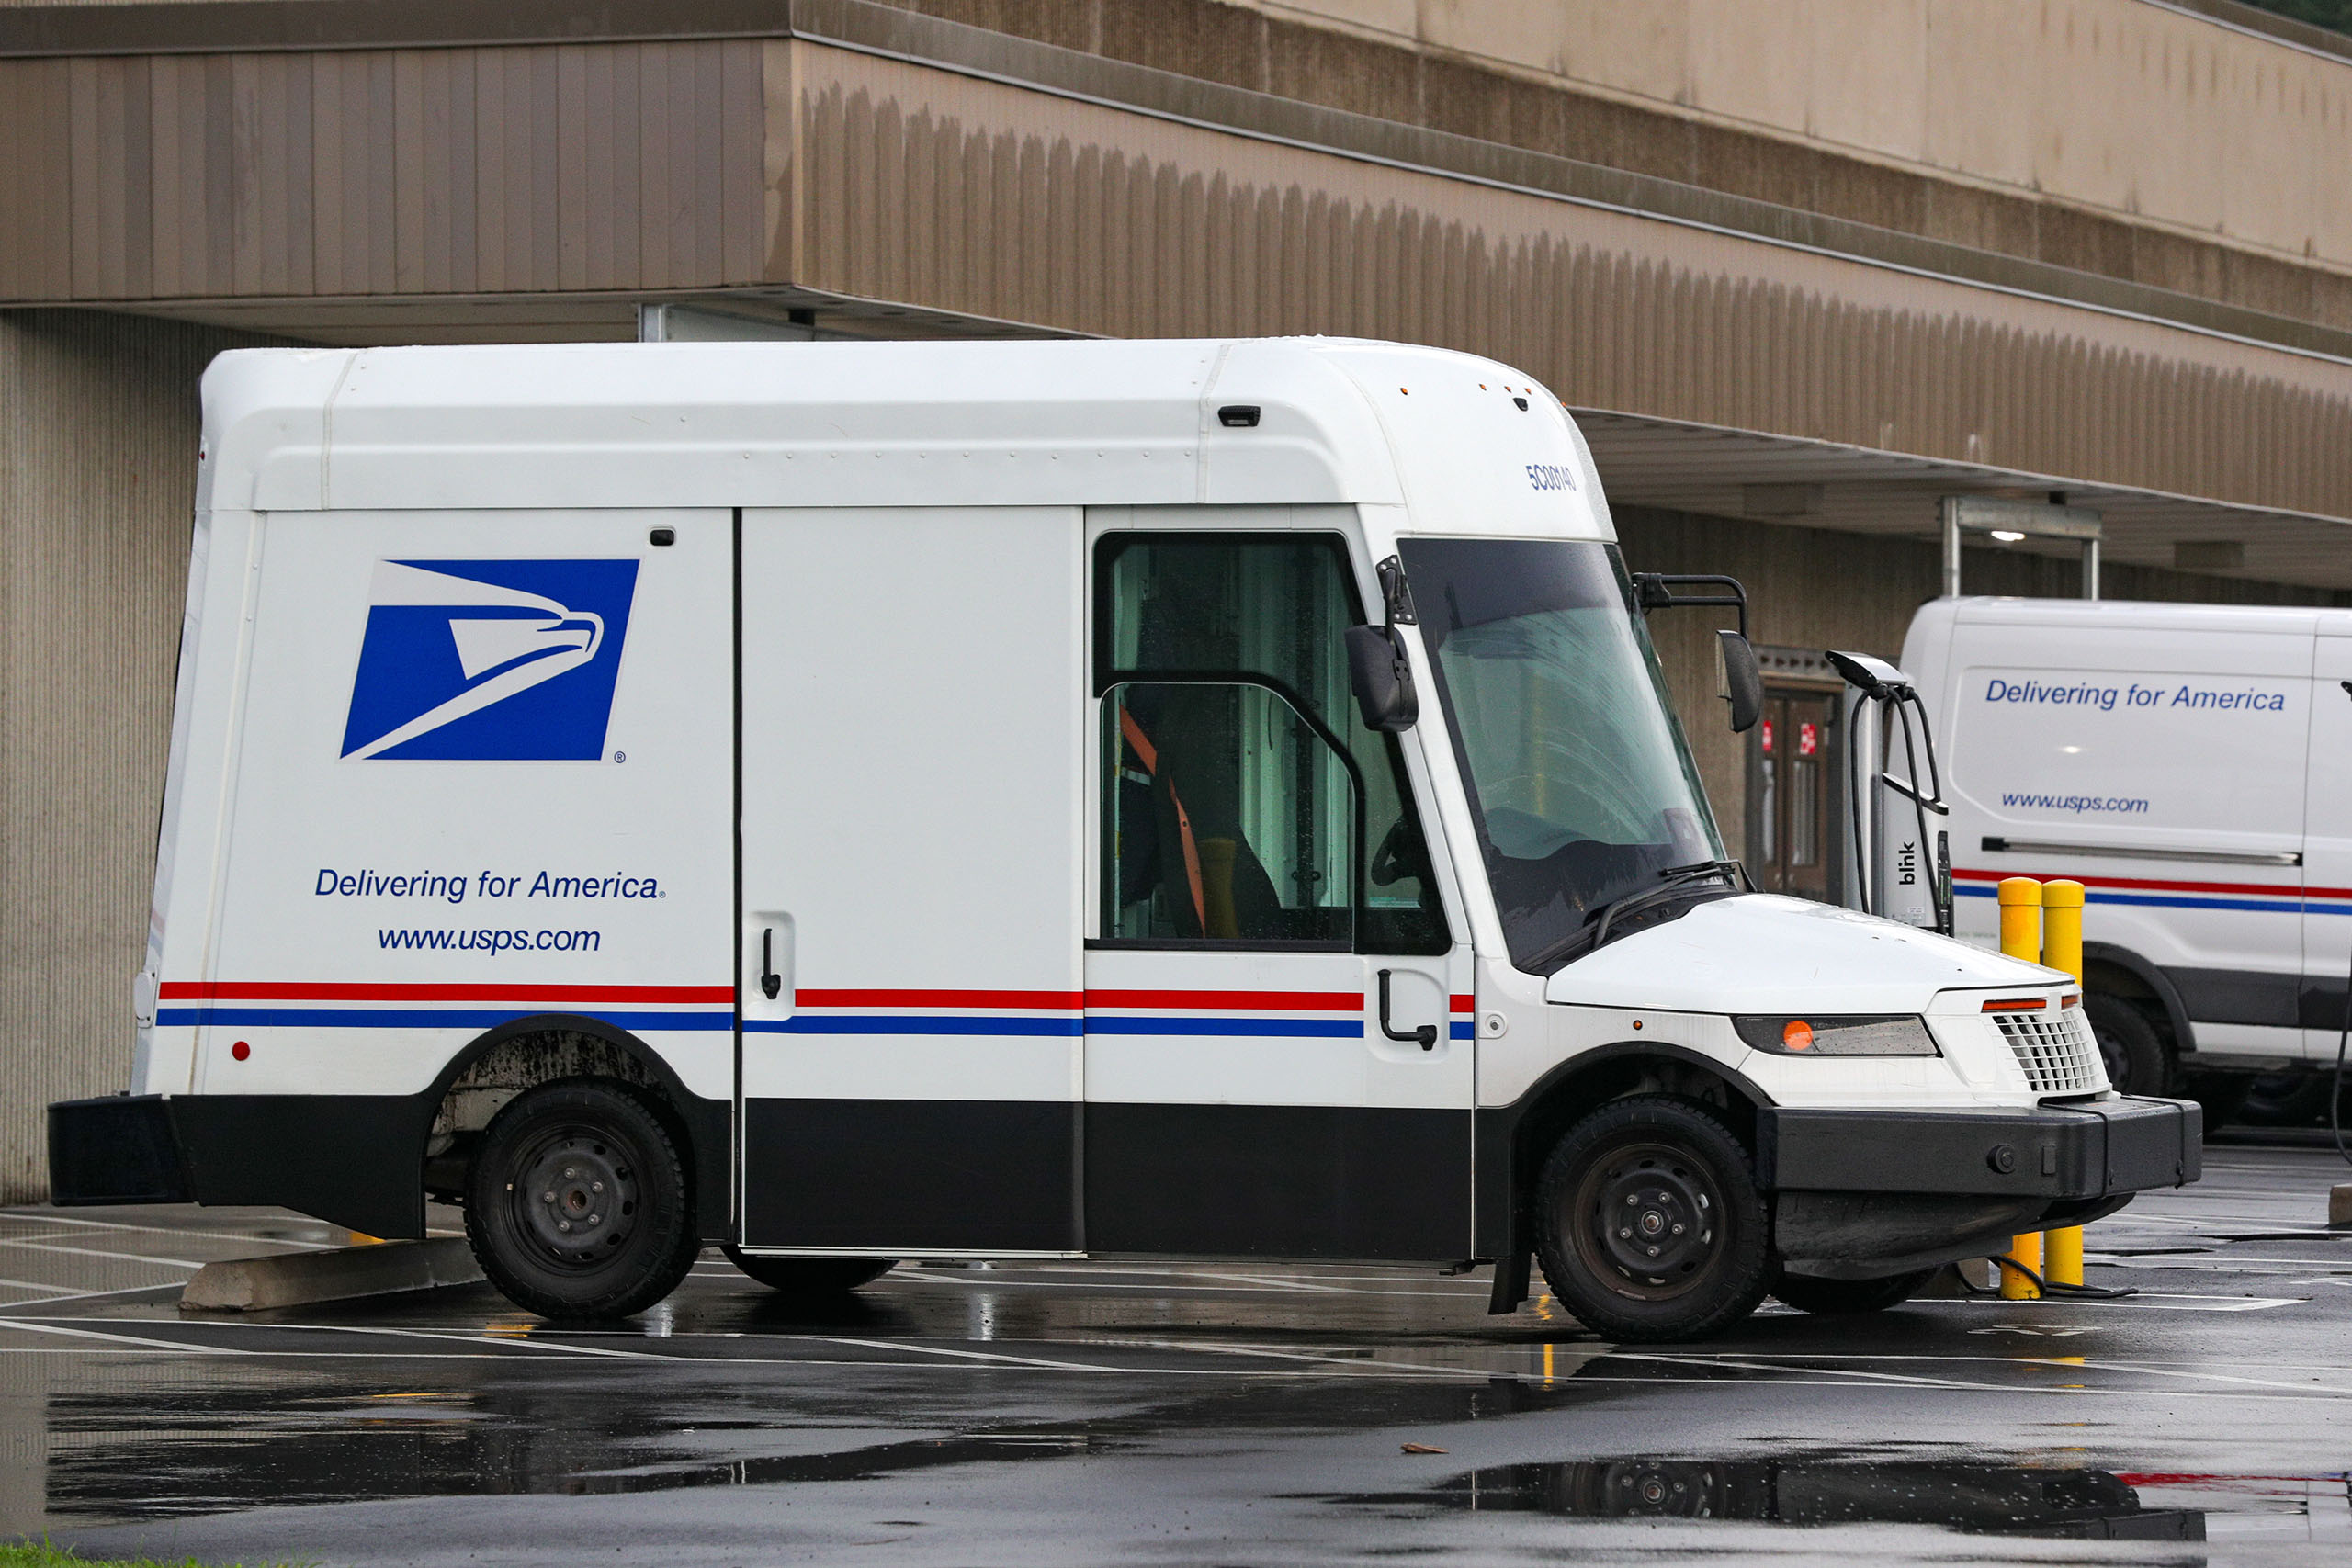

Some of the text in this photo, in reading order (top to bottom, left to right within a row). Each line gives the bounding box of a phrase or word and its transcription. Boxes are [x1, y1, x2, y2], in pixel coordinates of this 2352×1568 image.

[1985, 679, 2286, 712] Delivering for America
[2001, 792, 2150, 814] www.usps.com
[1898, 840, 1916, 886] blink
[315, 868, 468, 905] Delivering
[477, 869, 521, 897] for
[379, 929, 601, 956] www.usps.com
